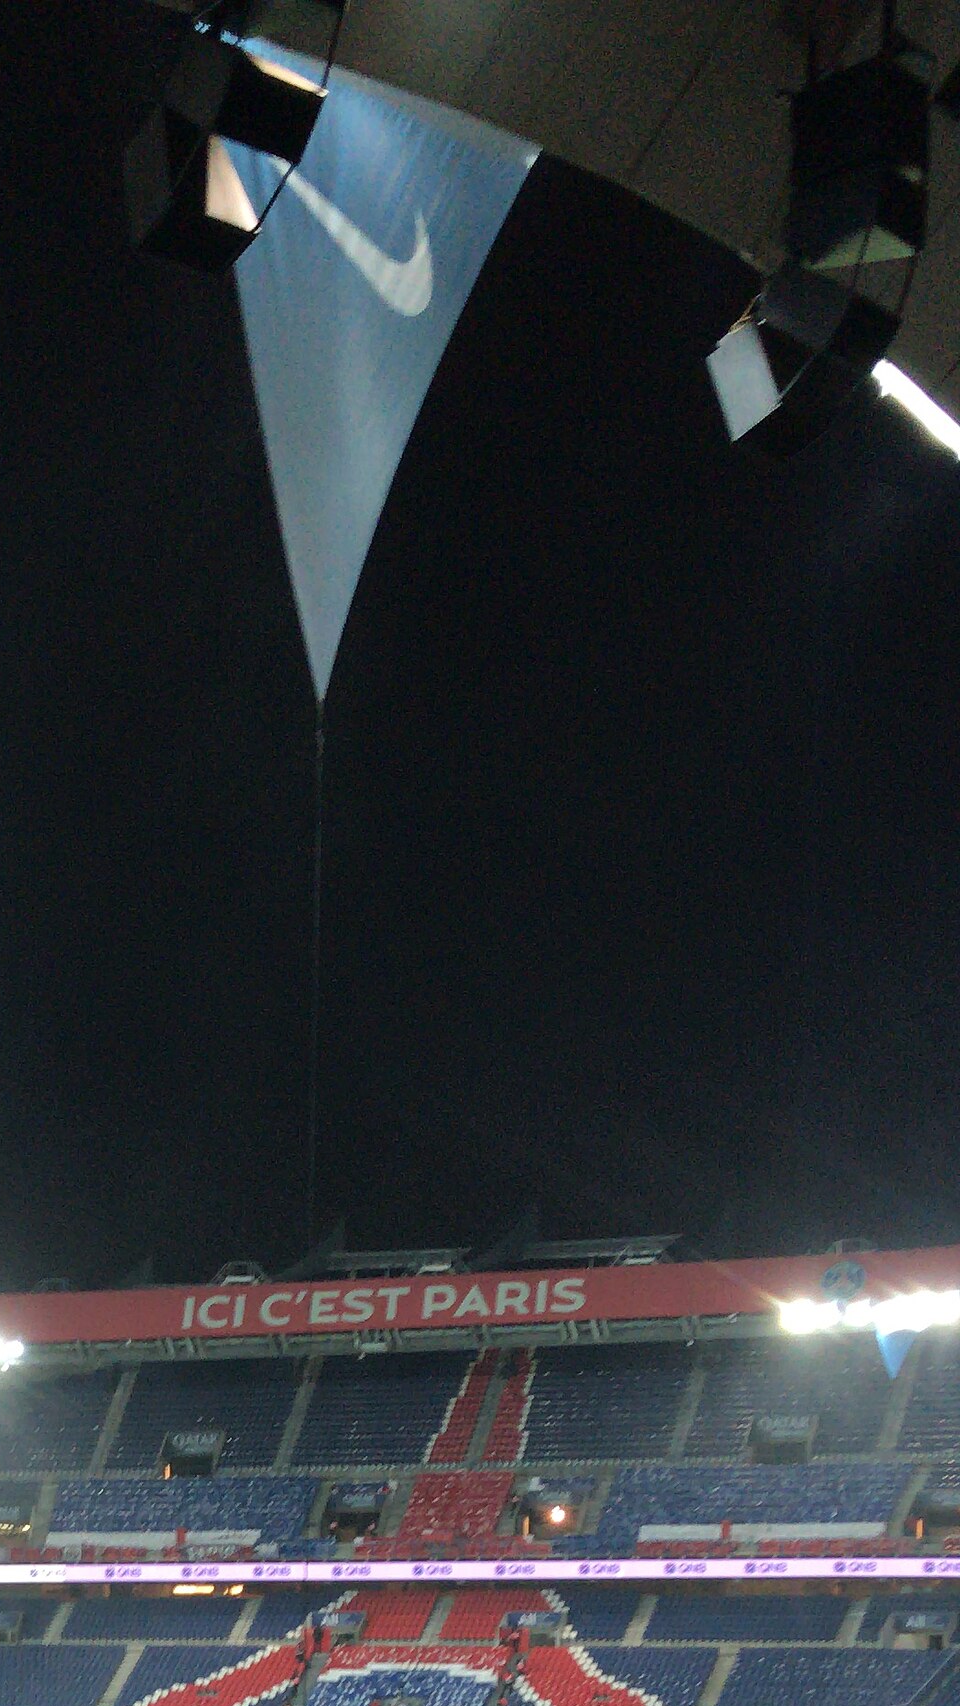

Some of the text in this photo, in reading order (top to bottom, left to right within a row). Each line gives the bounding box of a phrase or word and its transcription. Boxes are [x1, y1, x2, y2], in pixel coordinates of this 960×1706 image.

[181, 1278, 586, 1330] ICI C'EST PARIS
